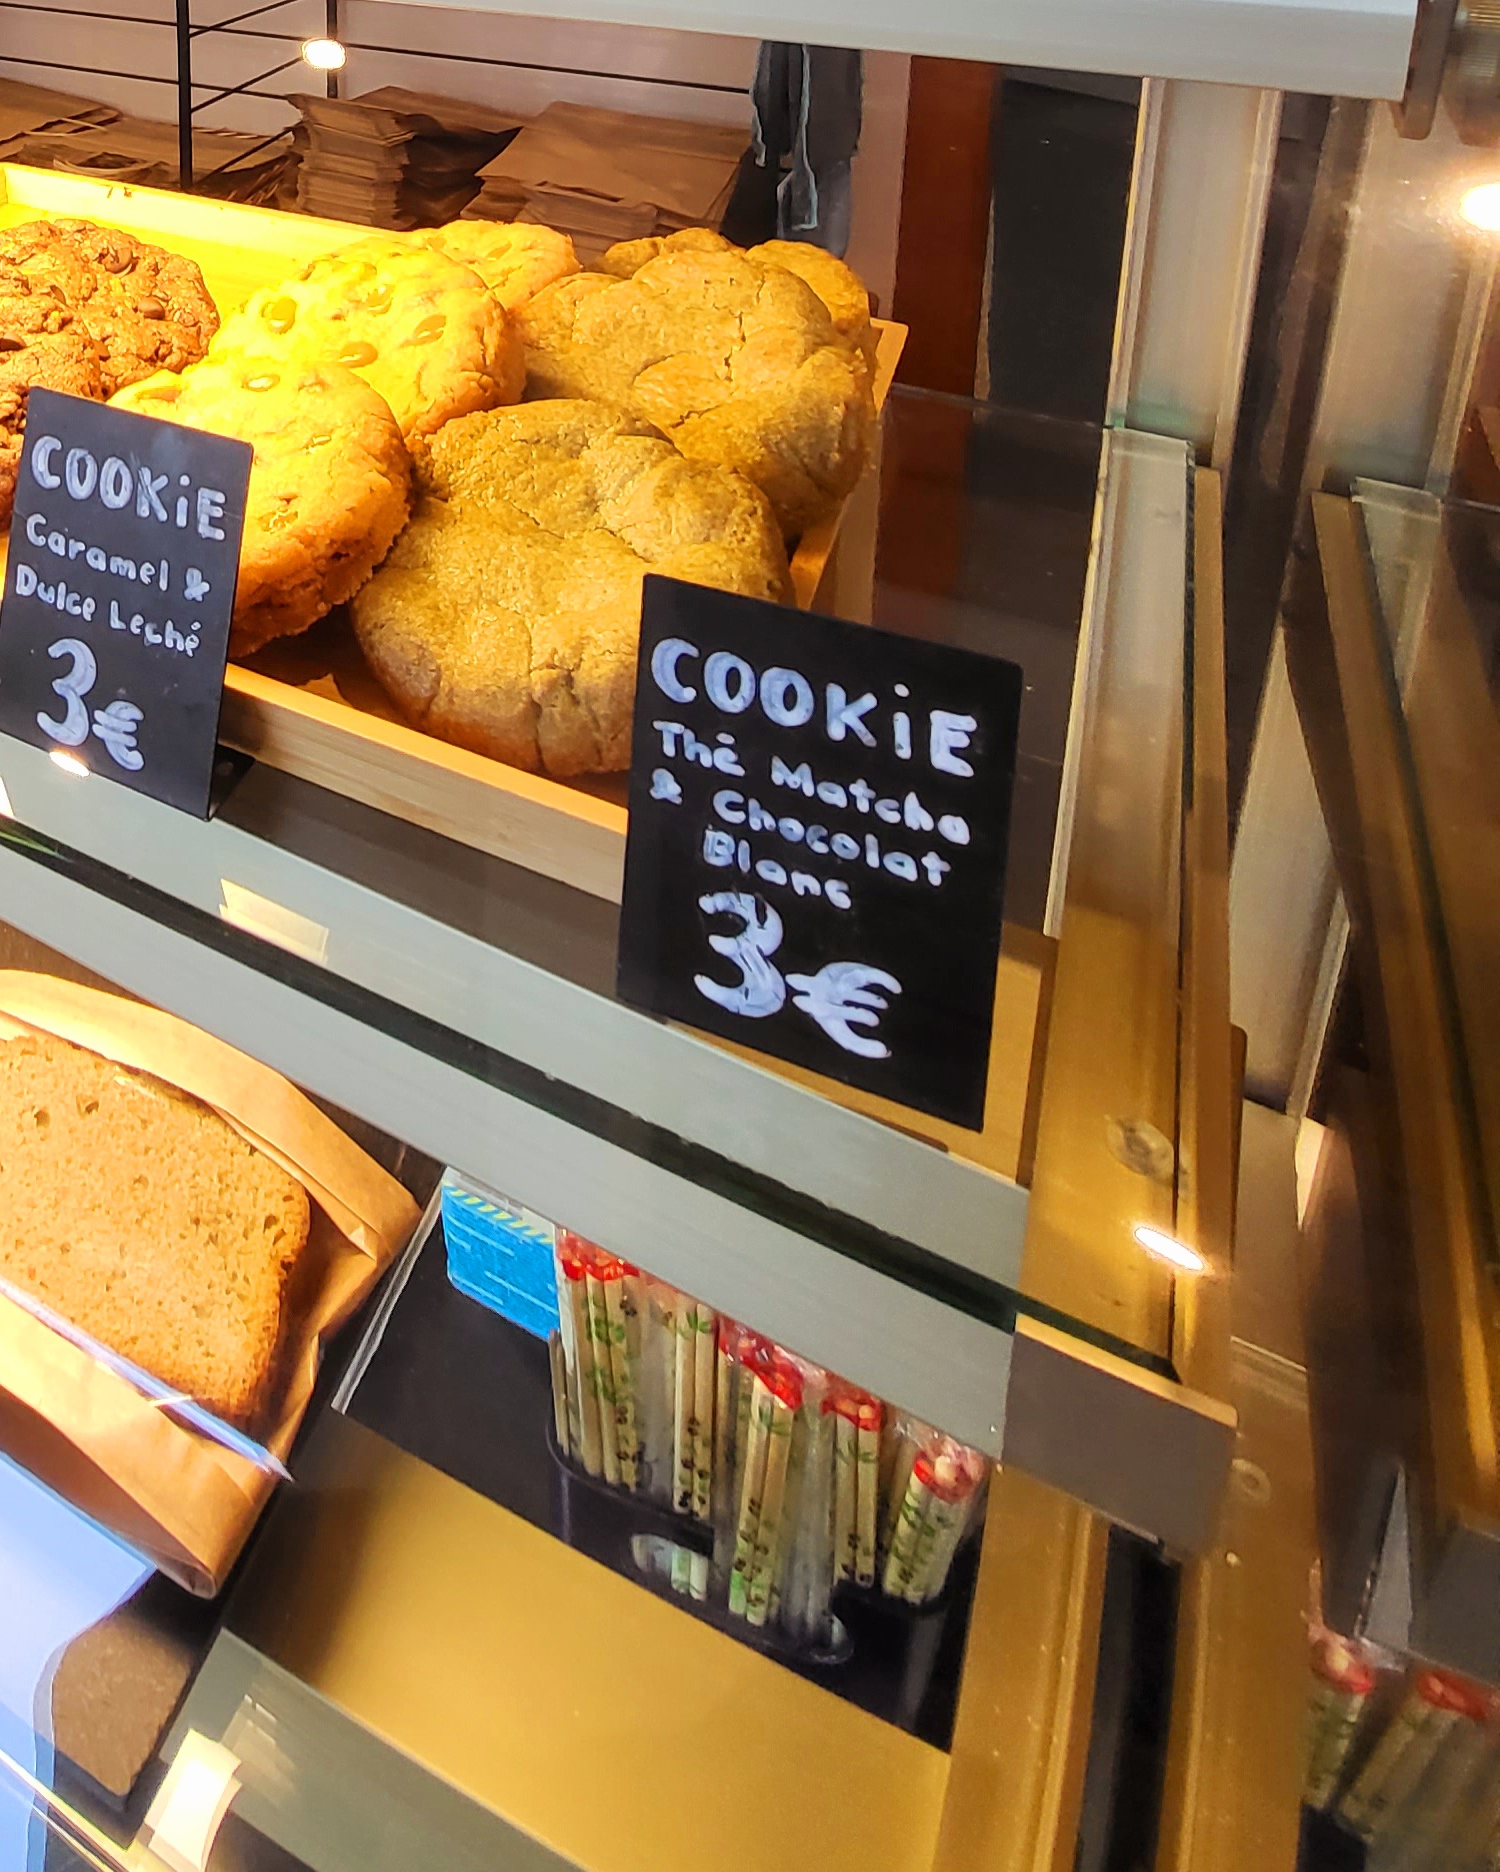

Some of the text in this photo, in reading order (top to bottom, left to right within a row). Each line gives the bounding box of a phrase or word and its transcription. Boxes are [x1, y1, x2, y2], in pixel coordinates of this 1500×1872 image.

[31, 435, 226, 540] COOKIE
[16, 564, 97, 621] Dulce
[27, 513, 169, 591] Caramel
[36, 637, 145, 771] 3€
[650, 637, 978, 777] COOKIE
[649, 768, 951, 887] & Chocolat
[772, 756, 970, 845] Matcha
[693, 891, 902, 1059] 3€
